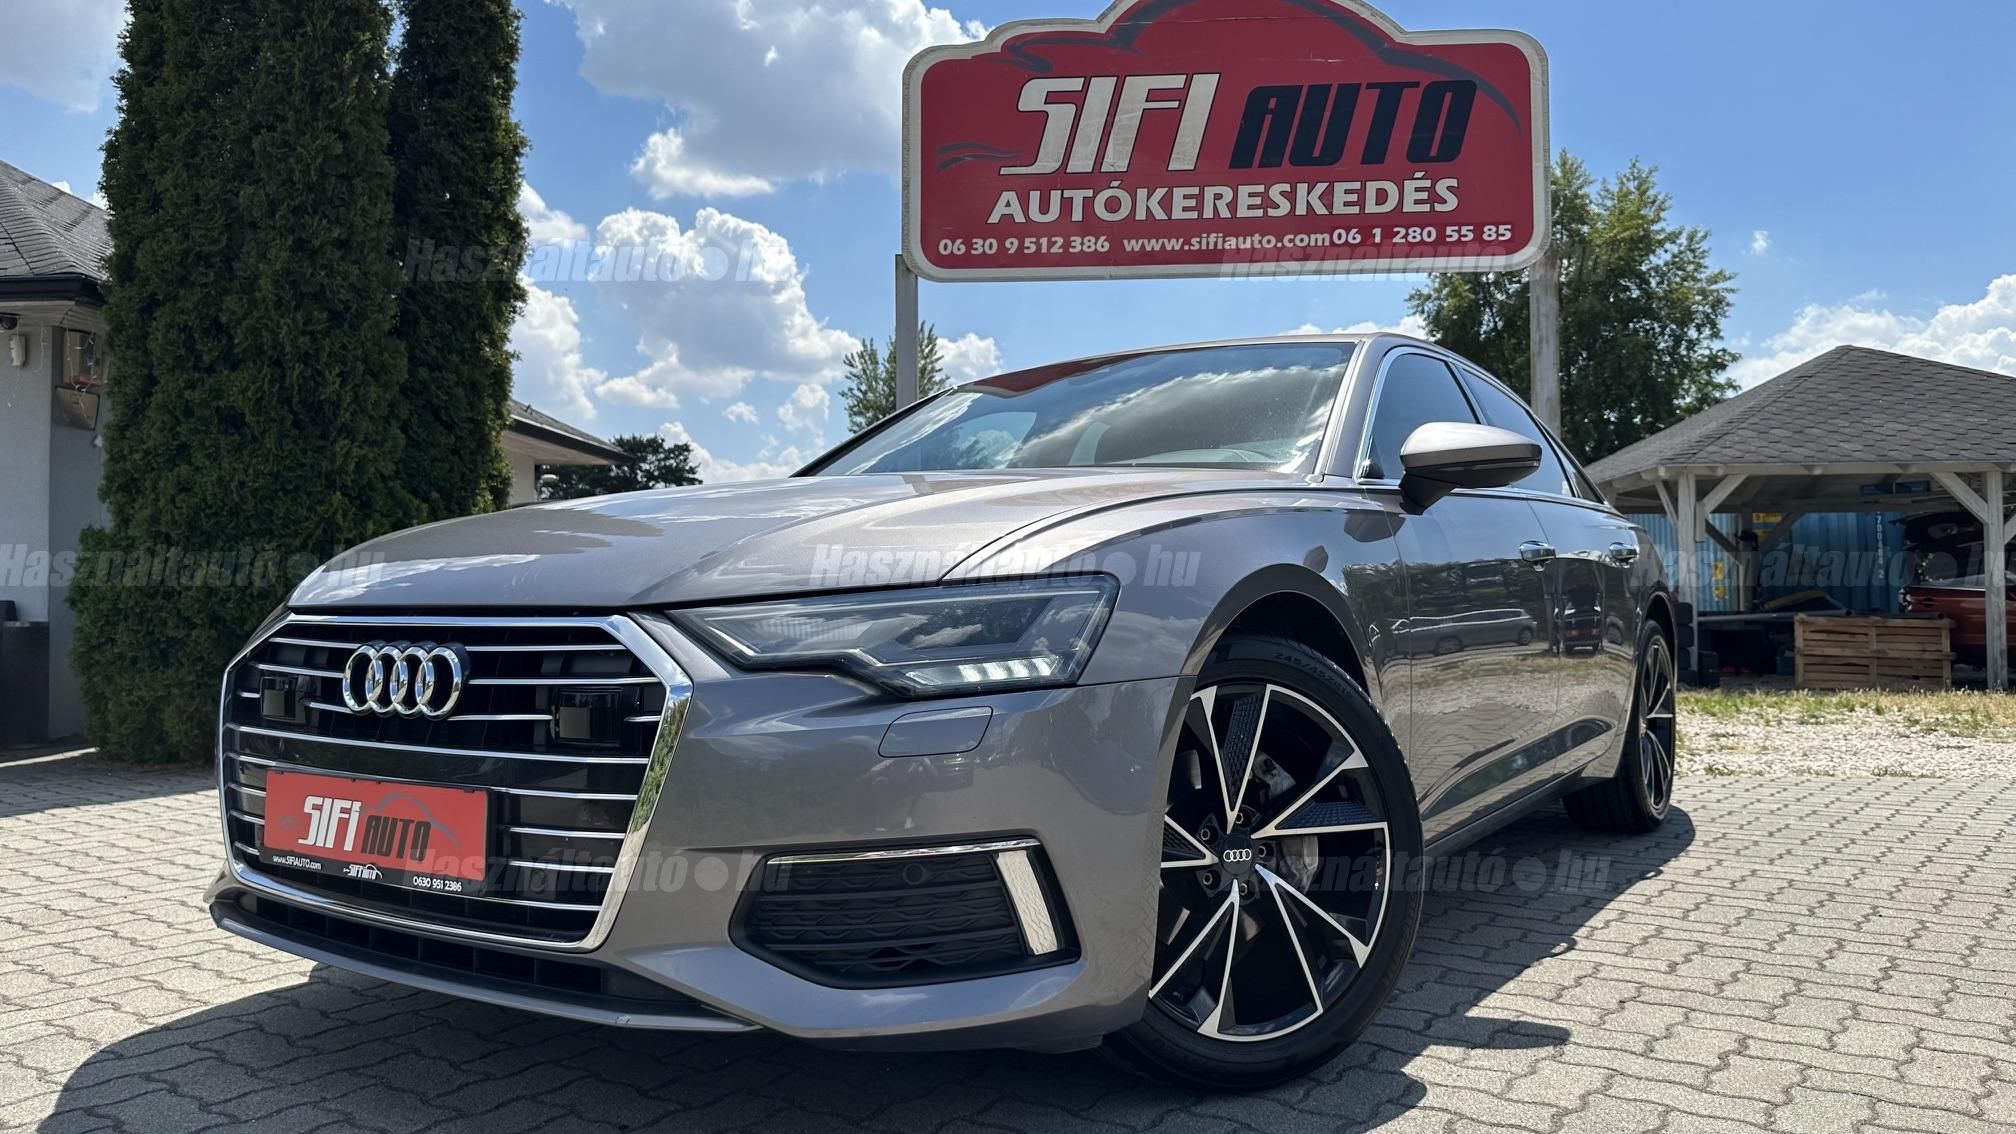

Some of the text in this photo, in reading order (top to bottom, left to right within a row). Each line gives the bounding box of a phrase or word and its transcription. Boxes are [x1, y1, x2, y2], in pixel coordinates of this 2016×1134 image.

[999, 73, 1478, 175] SIFI AUTO
[986, 171, 1460, 225] AUTÓKERESKEDÉS
[938, 238, 966, 255] 06
[970, 238, 998, 255] 30
[1069, 235, 1110, 252] 386
[1123, 231, 1330, 252] www.sifiauto.com
[1332, 228, 1361, 244] 06
[1372, 228, 1382, 243] 1
[1392, 226, 1437, 243] 280
[1445, 225, 1474, 242] 55
[1482, 224, 1512, 241] 85
[360, 814, 431, 861] AUTO
[412, 876, 462, 891] 0630 951 2386
